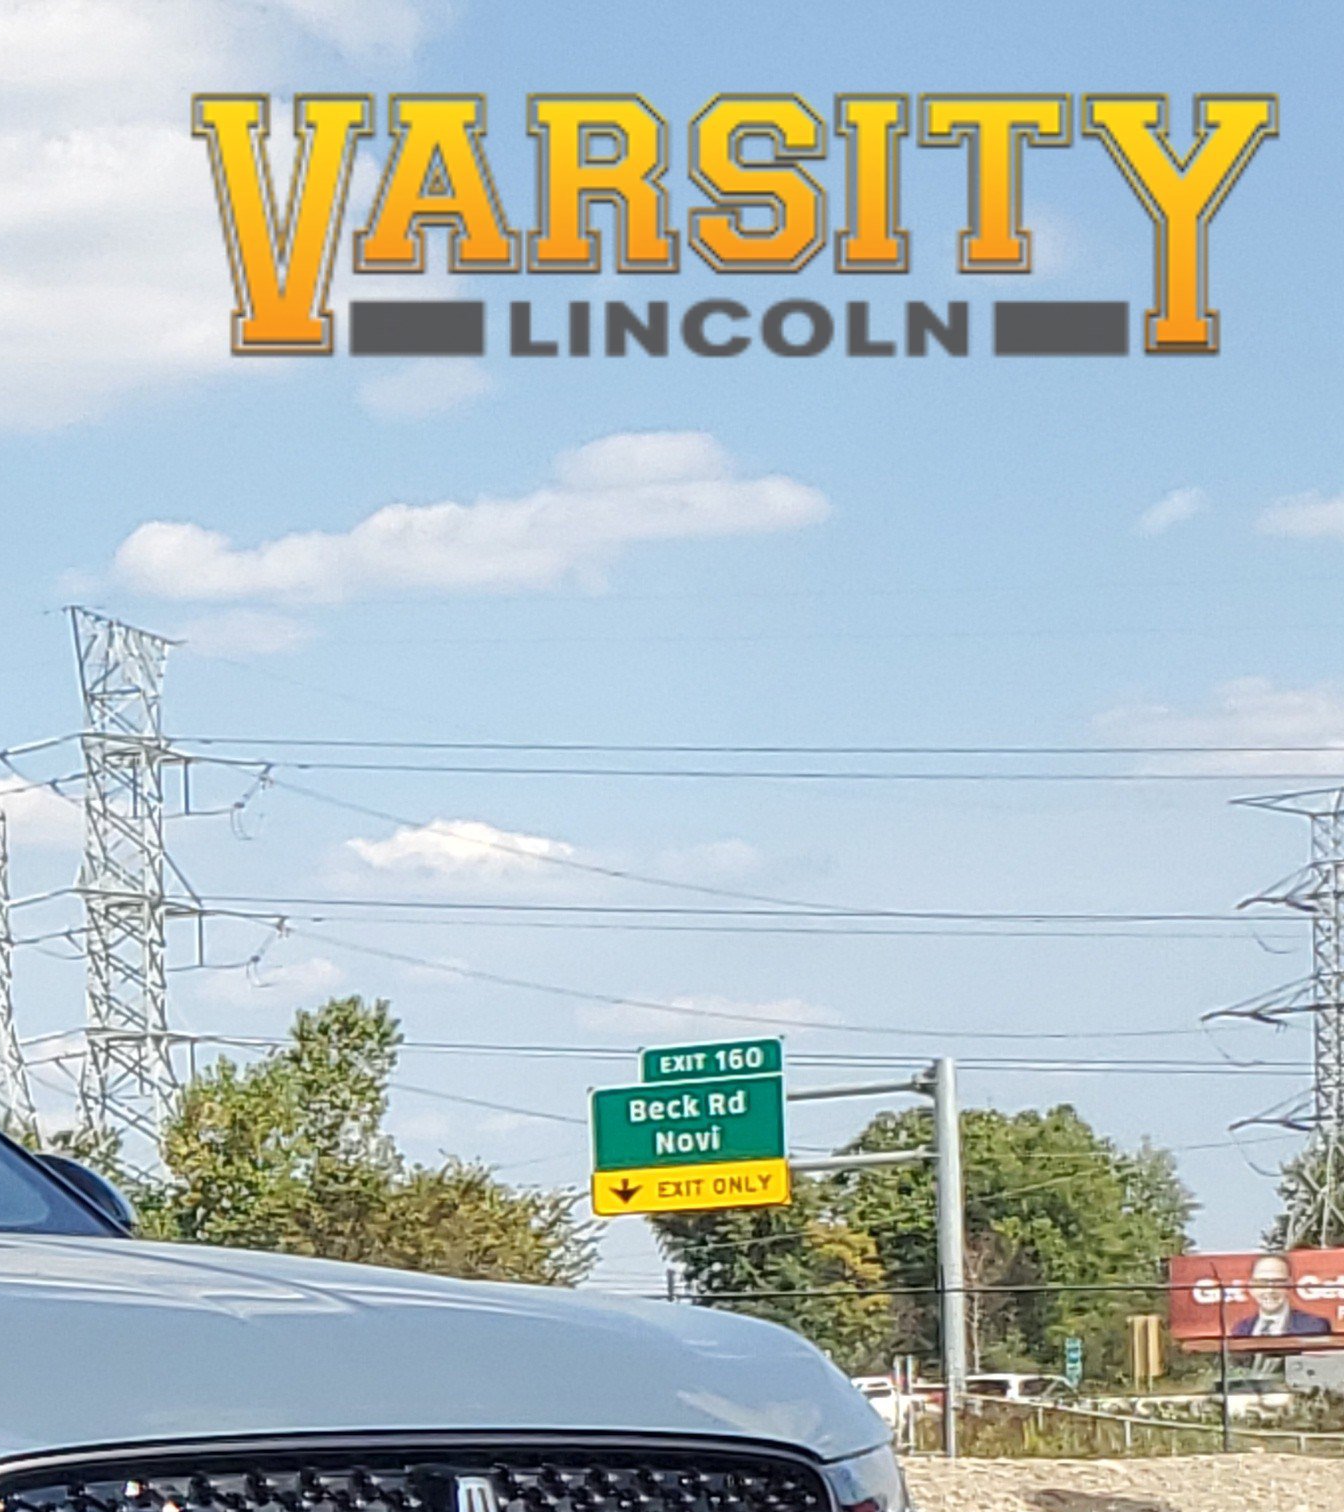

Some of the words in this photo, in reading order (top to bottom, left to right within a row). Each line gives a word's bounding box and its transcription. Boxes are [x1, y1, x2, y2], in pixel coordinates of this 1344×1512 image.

[660, 1053, 706, 1073] EXIT
[715, 1047, 764, 1071] 160
[629, 1094, 701, 1123] Beck
[708, 1090, 747, 1116] Rd
[655, 1125, 722, 1155] Novi
[657, 1179, 705, 1198] EXIT
[712, 1174, 773, 1195] ONLY
